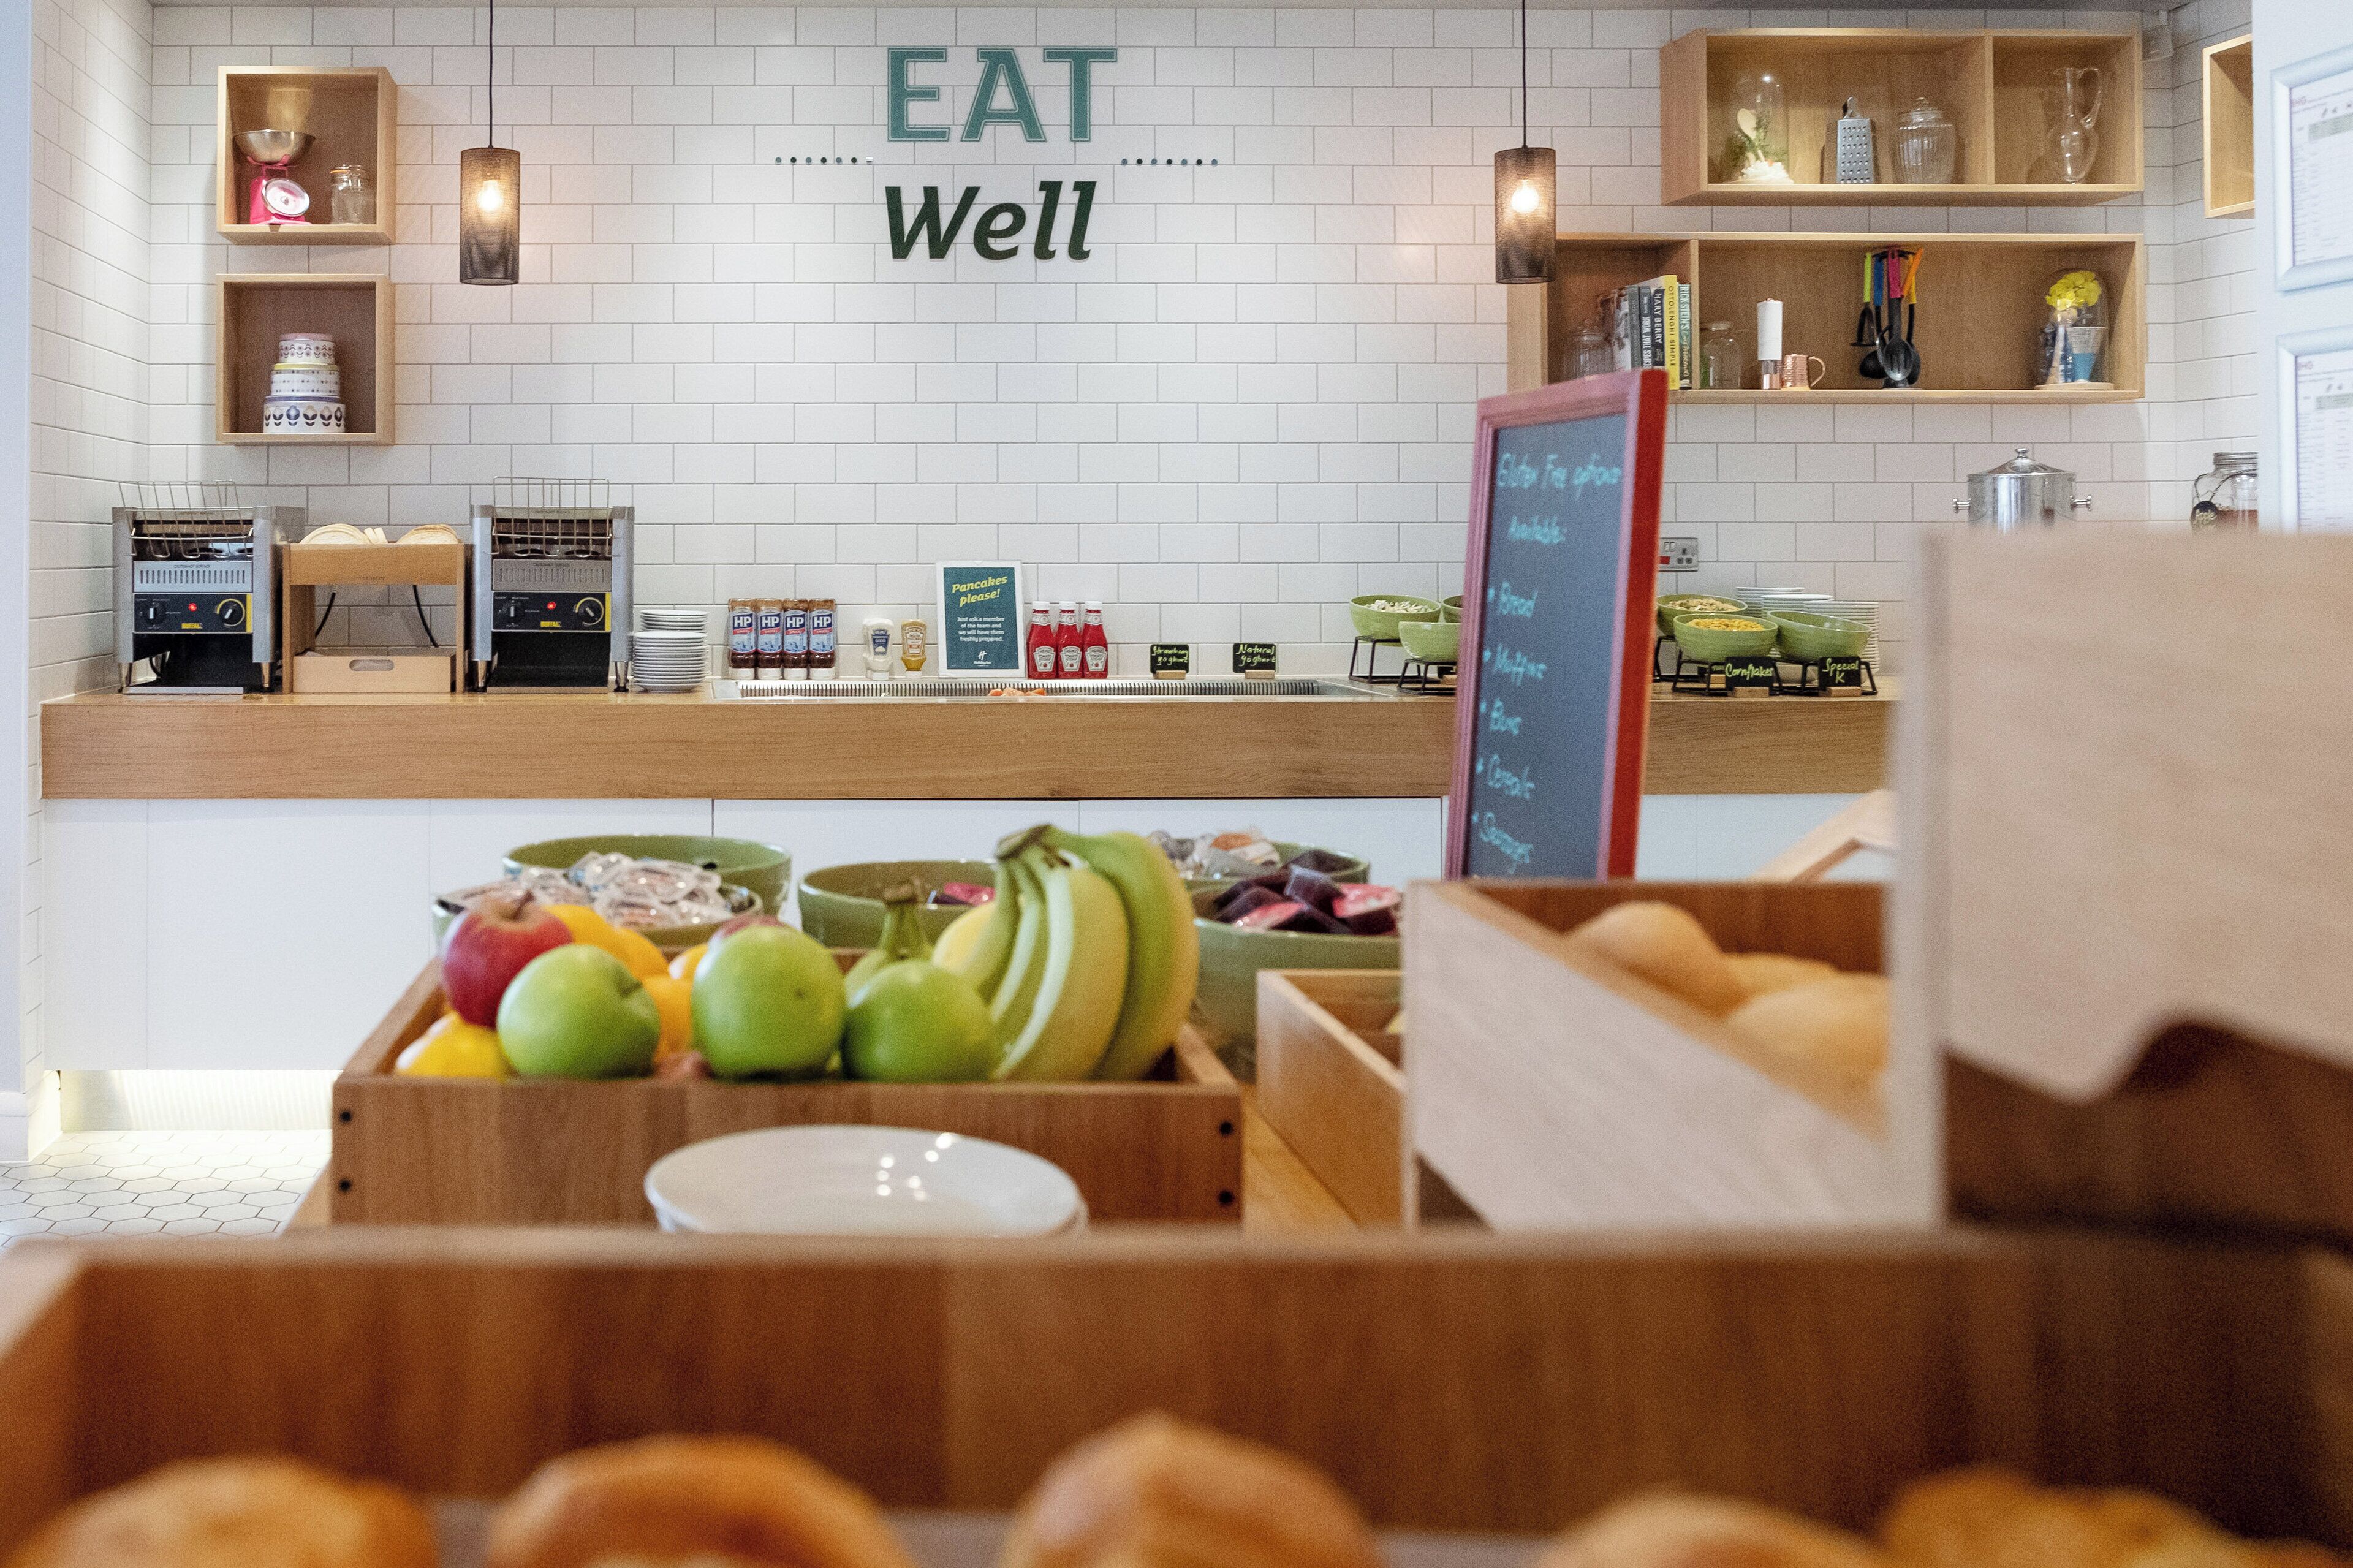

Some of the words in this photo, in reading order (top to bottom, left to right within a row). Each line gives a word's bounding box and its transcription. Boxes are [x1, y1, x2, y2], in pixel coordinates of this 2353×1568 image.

[887, 47, 1118, 143] EAT
[884, 180, 1097, 261] Well
[1680, 286, 1689, 302] RICK
[1642, 316, 1651, 333] WORK
[1680, 303, 1690, 330] STEIN'S
[952, 576, 1008, 594] Pancakes
[959, 588, 1001, 608] please!
[733, 616, 752, 627] HP
[761, 616, 779, 627] HP
[786, 616, 805, 628] HP
[813, 616, 832, 627] HP
[1235, 644, 1275, 655] Natural
[1822, 657, 1859, 676] Special
[1835, 670, 1845, 684] K
